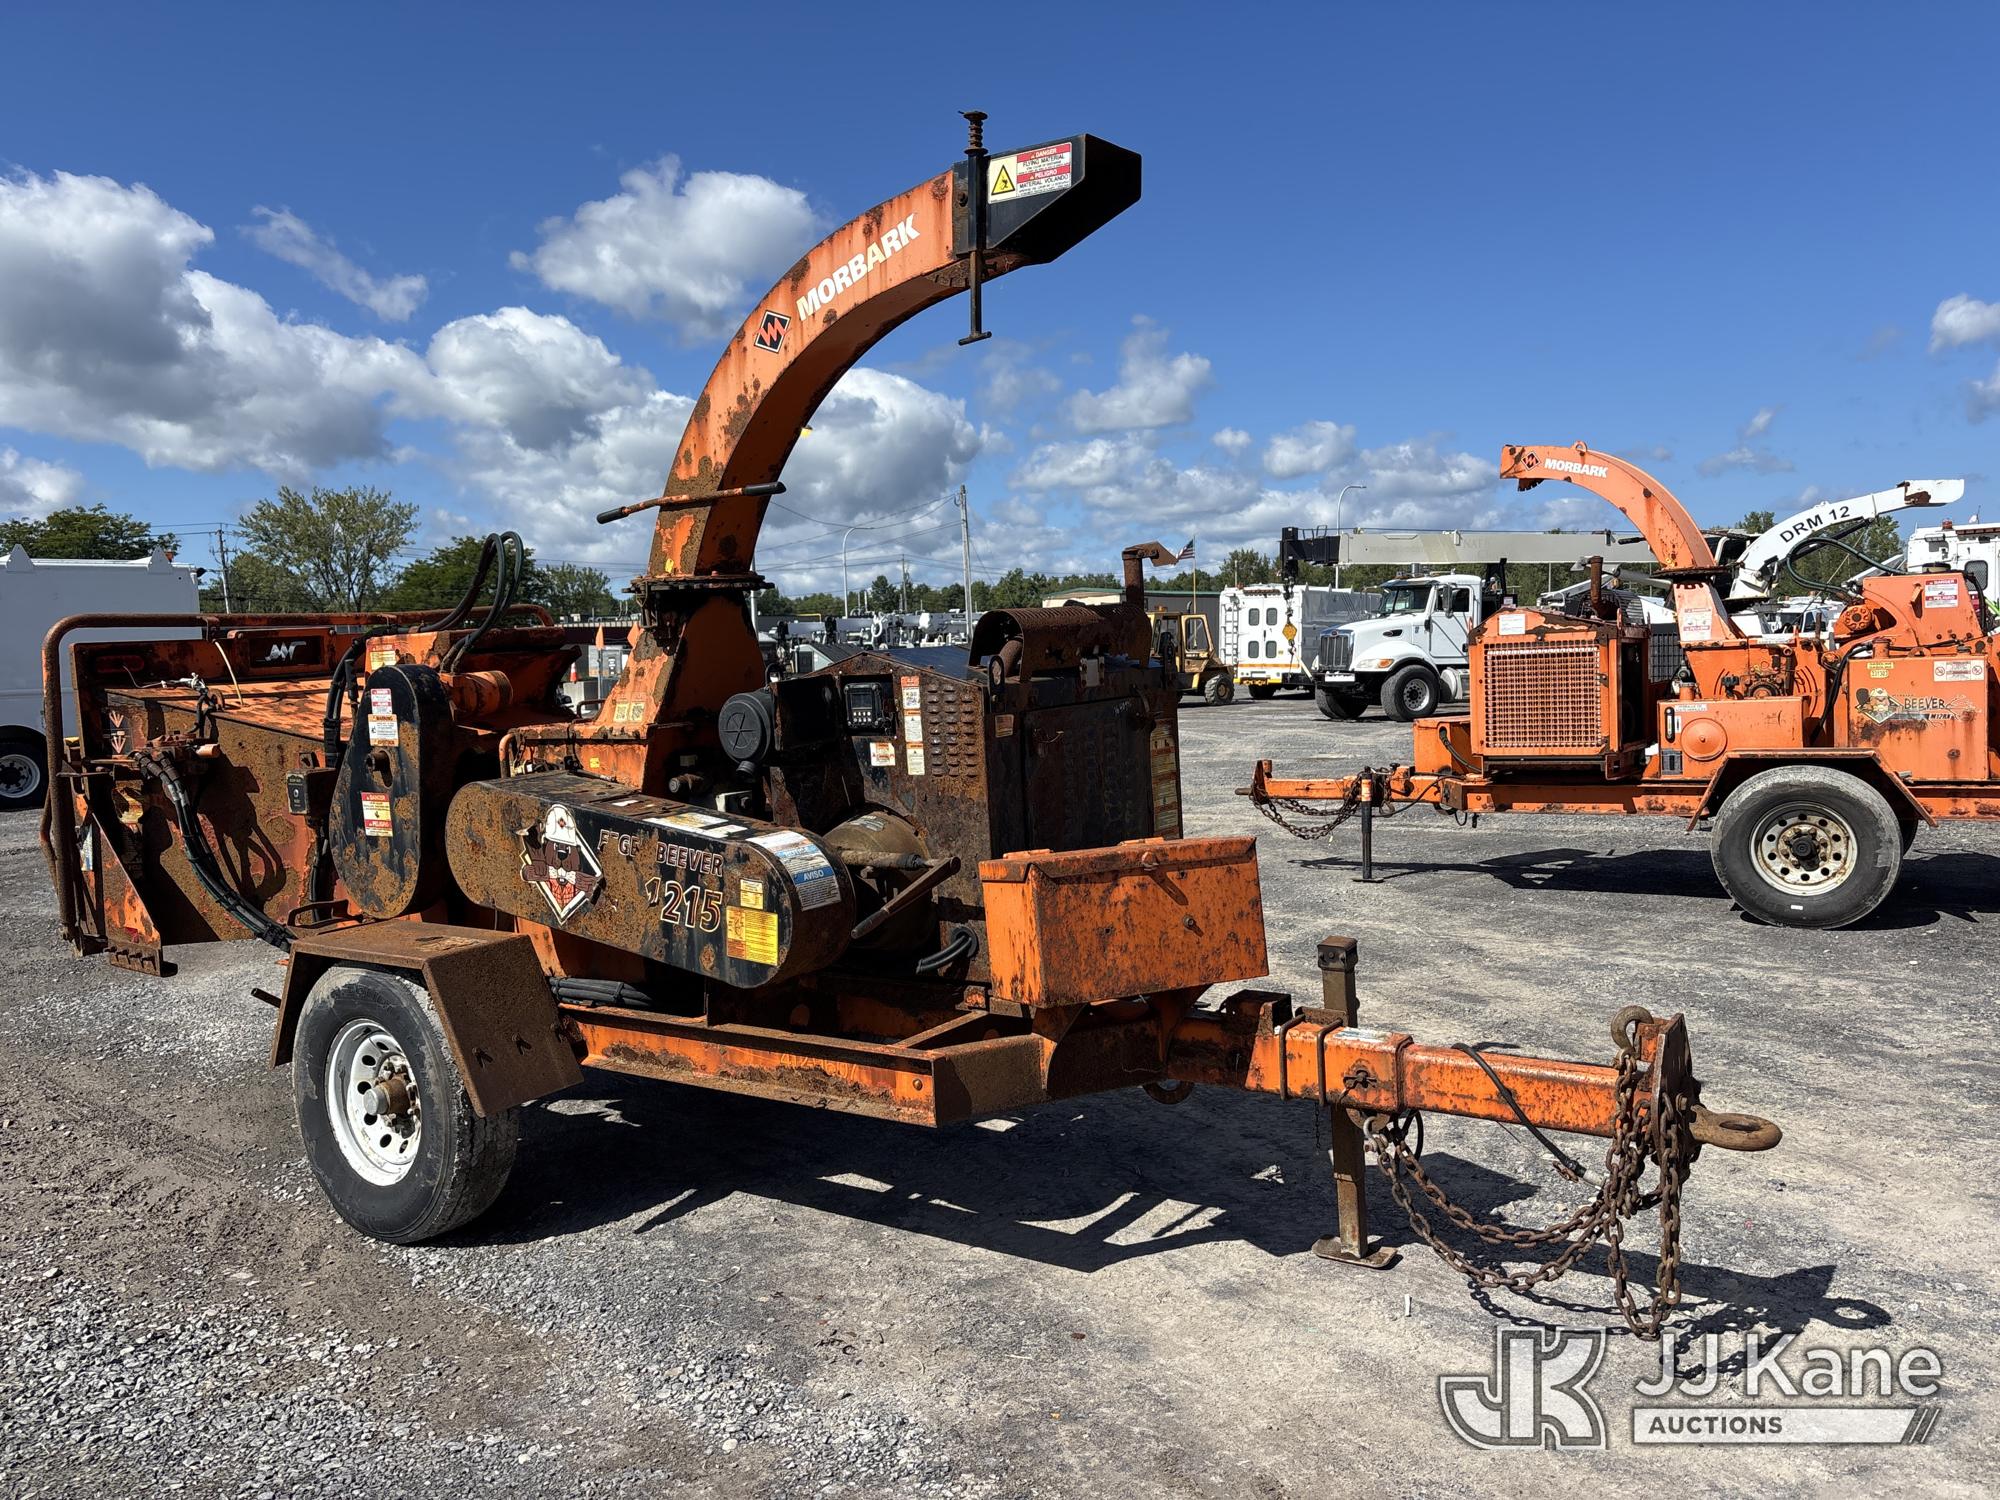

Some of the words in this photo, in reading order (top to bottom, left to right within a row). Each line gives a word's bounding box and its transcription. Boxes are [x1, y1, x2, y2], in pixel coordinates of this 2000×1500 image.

[1022, 159, 1040, 167] FLYING
[1041, 153, 1065, 163] MATERIAL
[1035, 148, 1057, 158] DANGER
[1019, 180, 1043, 188] MATERIAL
[1044, 174, 1069, 184] VOLANDO
[1034, 169, 1058, 179] PELIGRO
[795, 213, 920, 321] MORBARK
[1544, 458, 1608, 478] MORBARK
[1780, 514, 1823, 543] DRM
[1829, 506, 1850, 520] 12
[1904, 695, 1945, 710] BEEVER
[656, 841, 724, 877] BEEVER
[803, 869, 825, 881] AVISO
[645, 876, 723, 933] 1215
